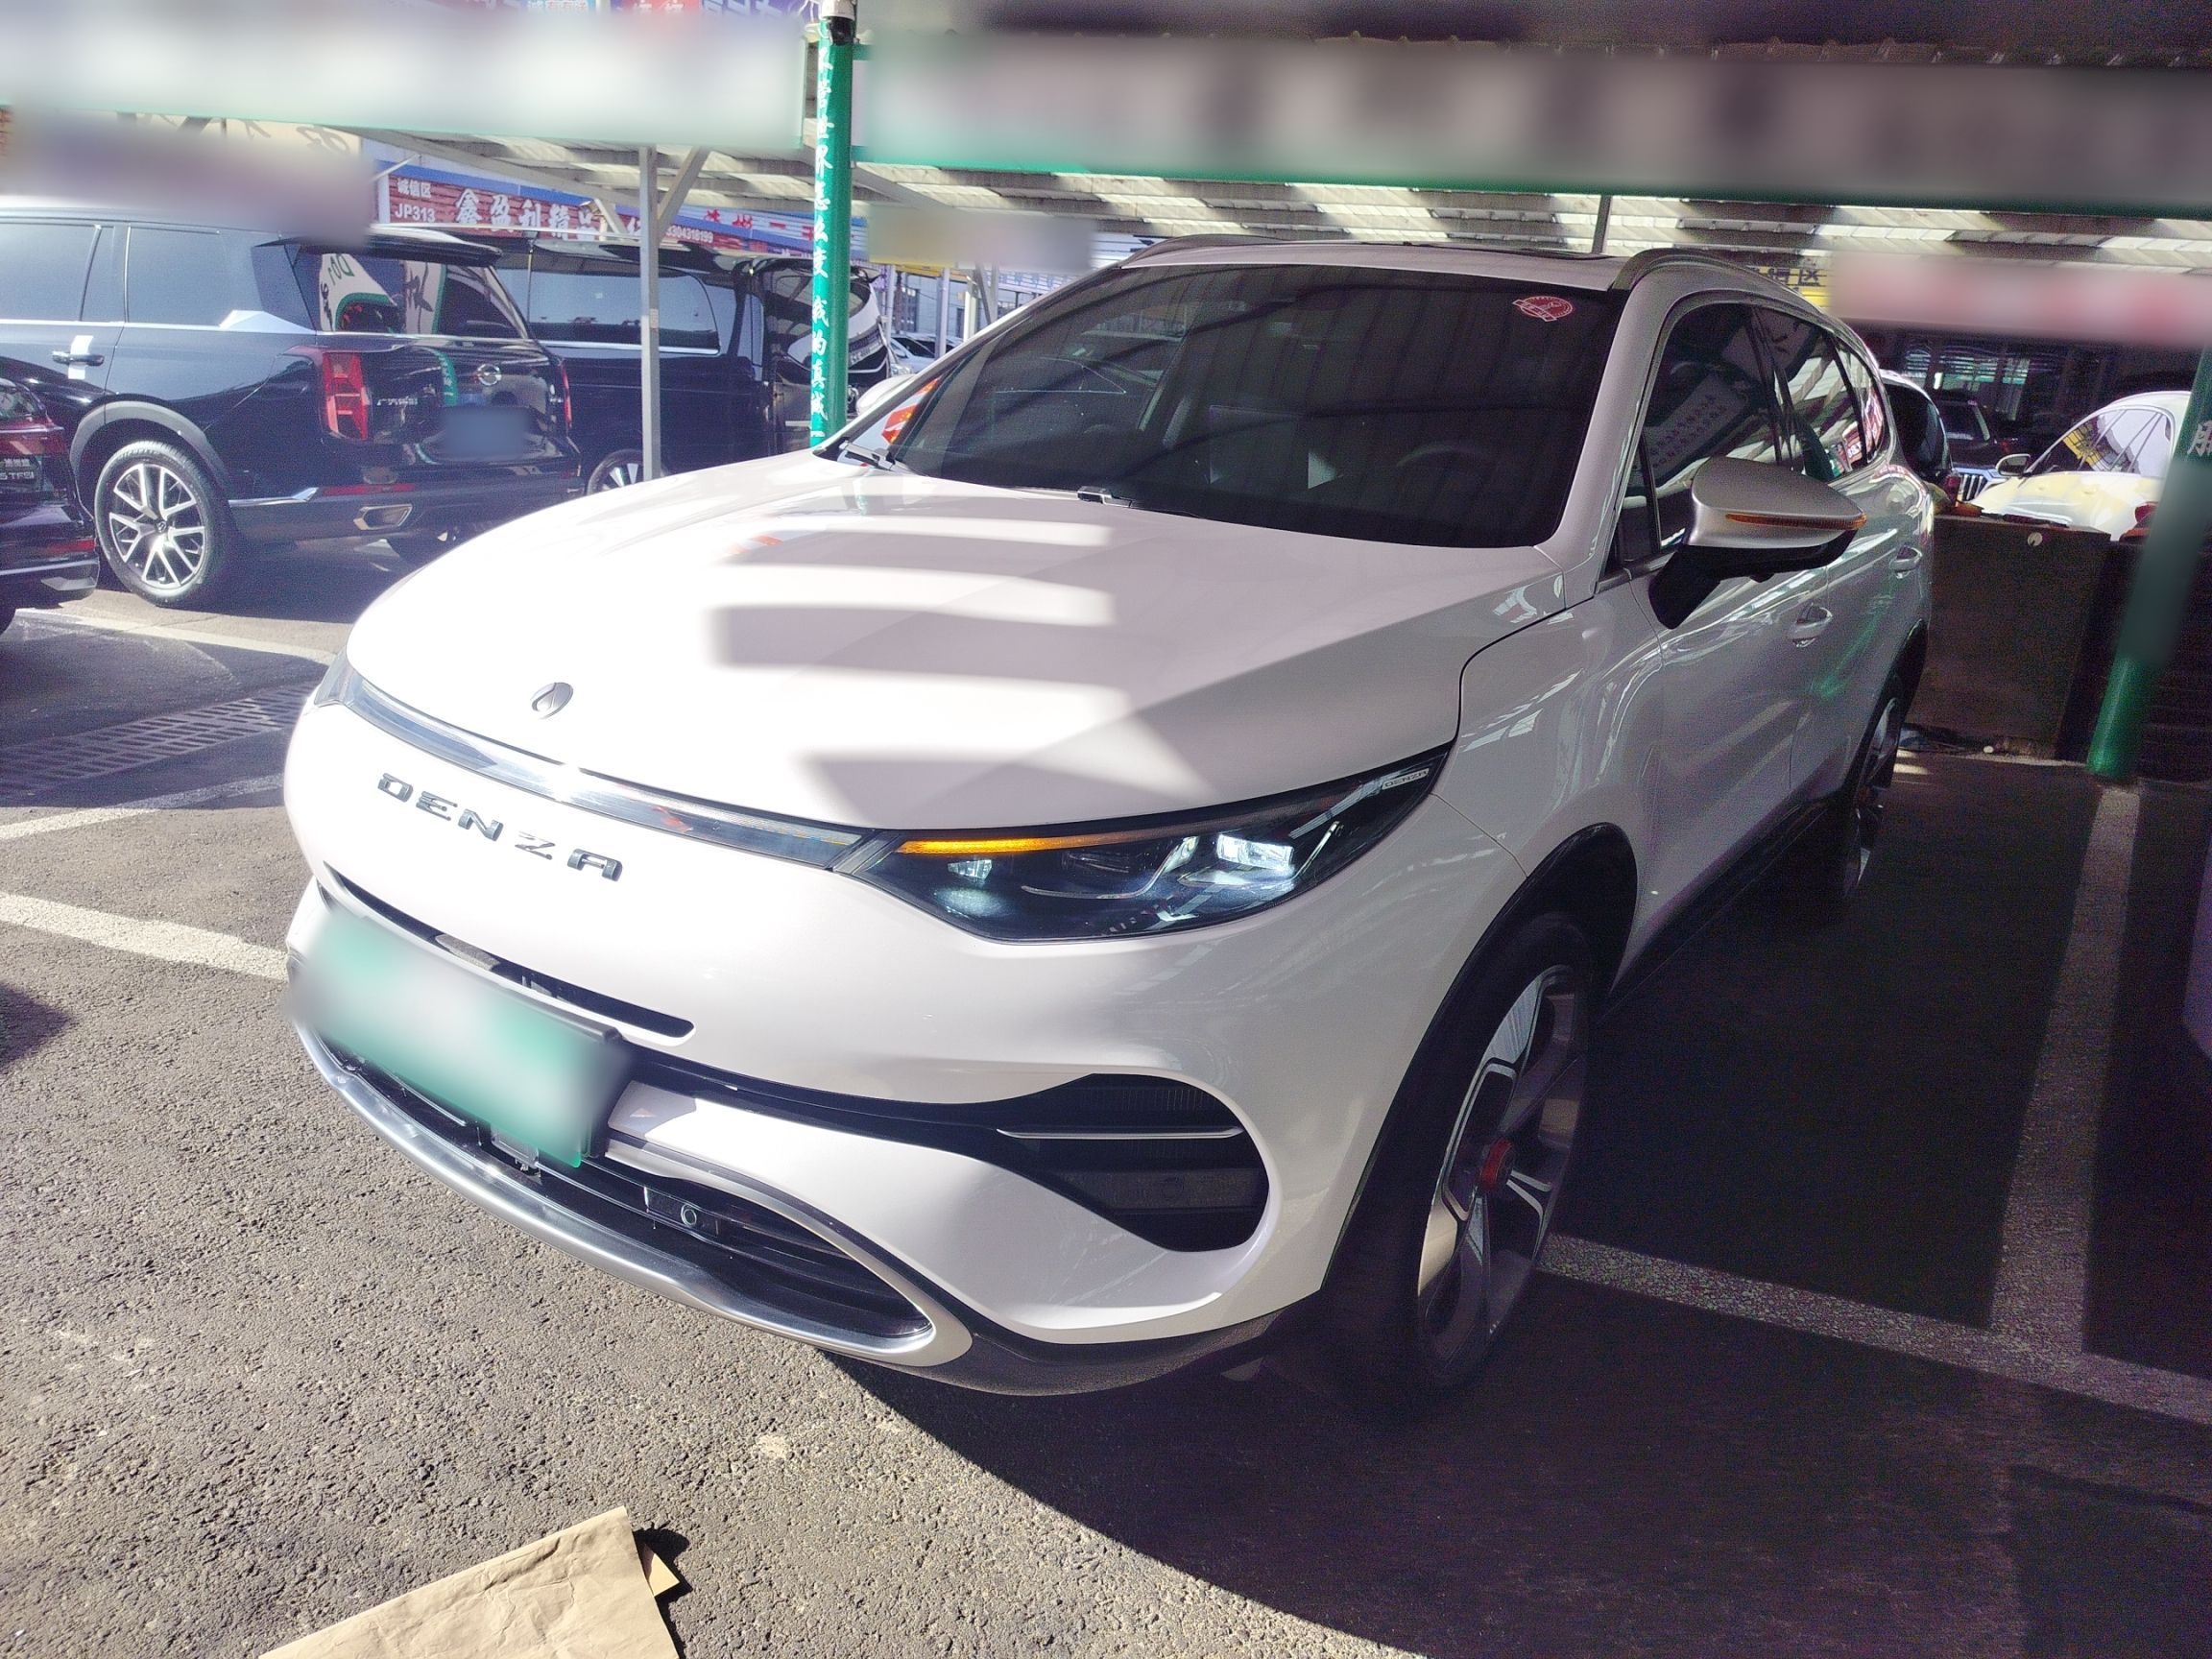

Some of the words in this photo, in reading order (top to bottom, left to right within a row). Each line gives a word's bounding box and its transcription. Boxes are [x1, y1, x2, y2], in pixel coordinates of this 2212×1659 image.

[397, 178, 432, 199] 诚信区
[395, 204, 436, 223] JP313
[1384, 770, 1428, 787] DENZA
[377, 773, 623, 882] DENZA
